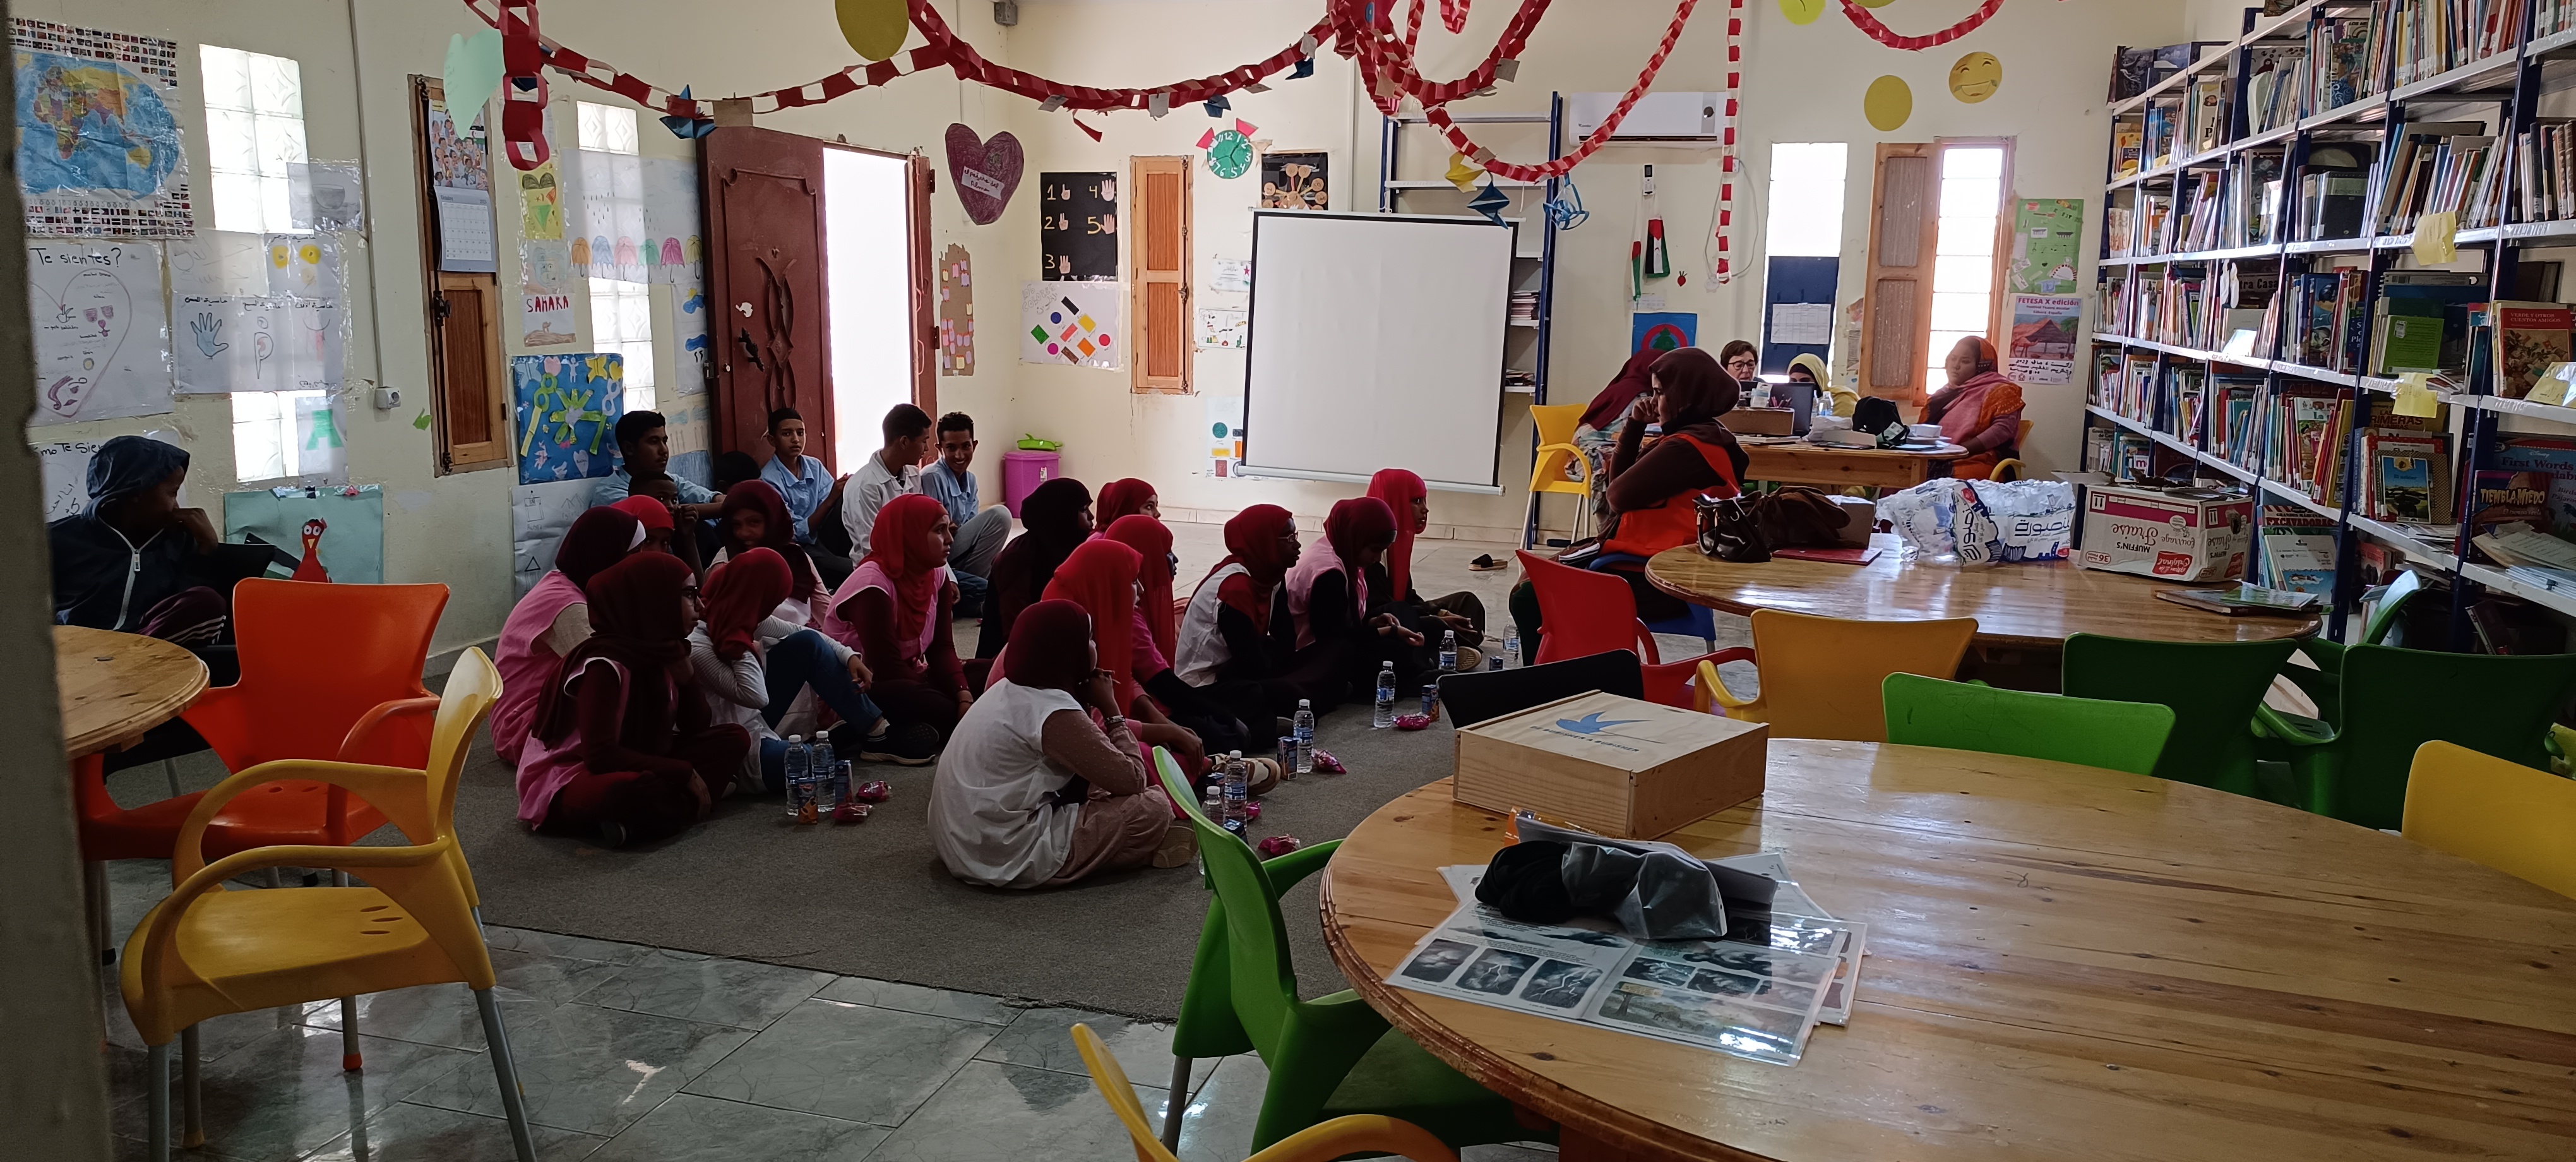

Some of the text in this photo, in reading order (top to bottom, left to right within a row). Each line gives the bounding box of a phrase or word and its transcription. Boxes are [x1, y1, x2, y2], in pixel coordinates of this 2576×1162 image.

[1224, 132, 1233, 140] 12
[1241, 139, 1249, 149] 2
[1244, 152, 1251, 162] 3
[1220, 168, 1226, 176] 6
[1231, 167, 1237, 177] 5
[1239, 163, 1246, 174] 4
[1047, 184, 1056, 200] 1
[1089, 186, 1097, 198] 4
[1044, 216, 1055, 229] 2
[1087, 216, 1101, 234] 5
[29, 248, 52, 265] Te
[1045, 254, 1056, 268] 3
[2257, 278, 2278, 289] Casa
[526, 295, 569, 313] SAHARA
[2370, 415, 2423, 426] RIMERAS
[54, 443, 72, 452] Te
[2527, 448, 2550, 459] Disney
[2501, 457, 2574, 471] First Words
[2480, 488, 2517, 504] TIEMBLA
[2111, 524, 2159, 546] Fraise
[2116, 541, 2150, 553] MUFFIN'S
[2099, 554, 2110, 563] 36
[2157, 557, 2191, 567] Original
[1542, 728, 1585, 740] BUBISHER
[1594, 740, 1640, 752] BUBISHER
